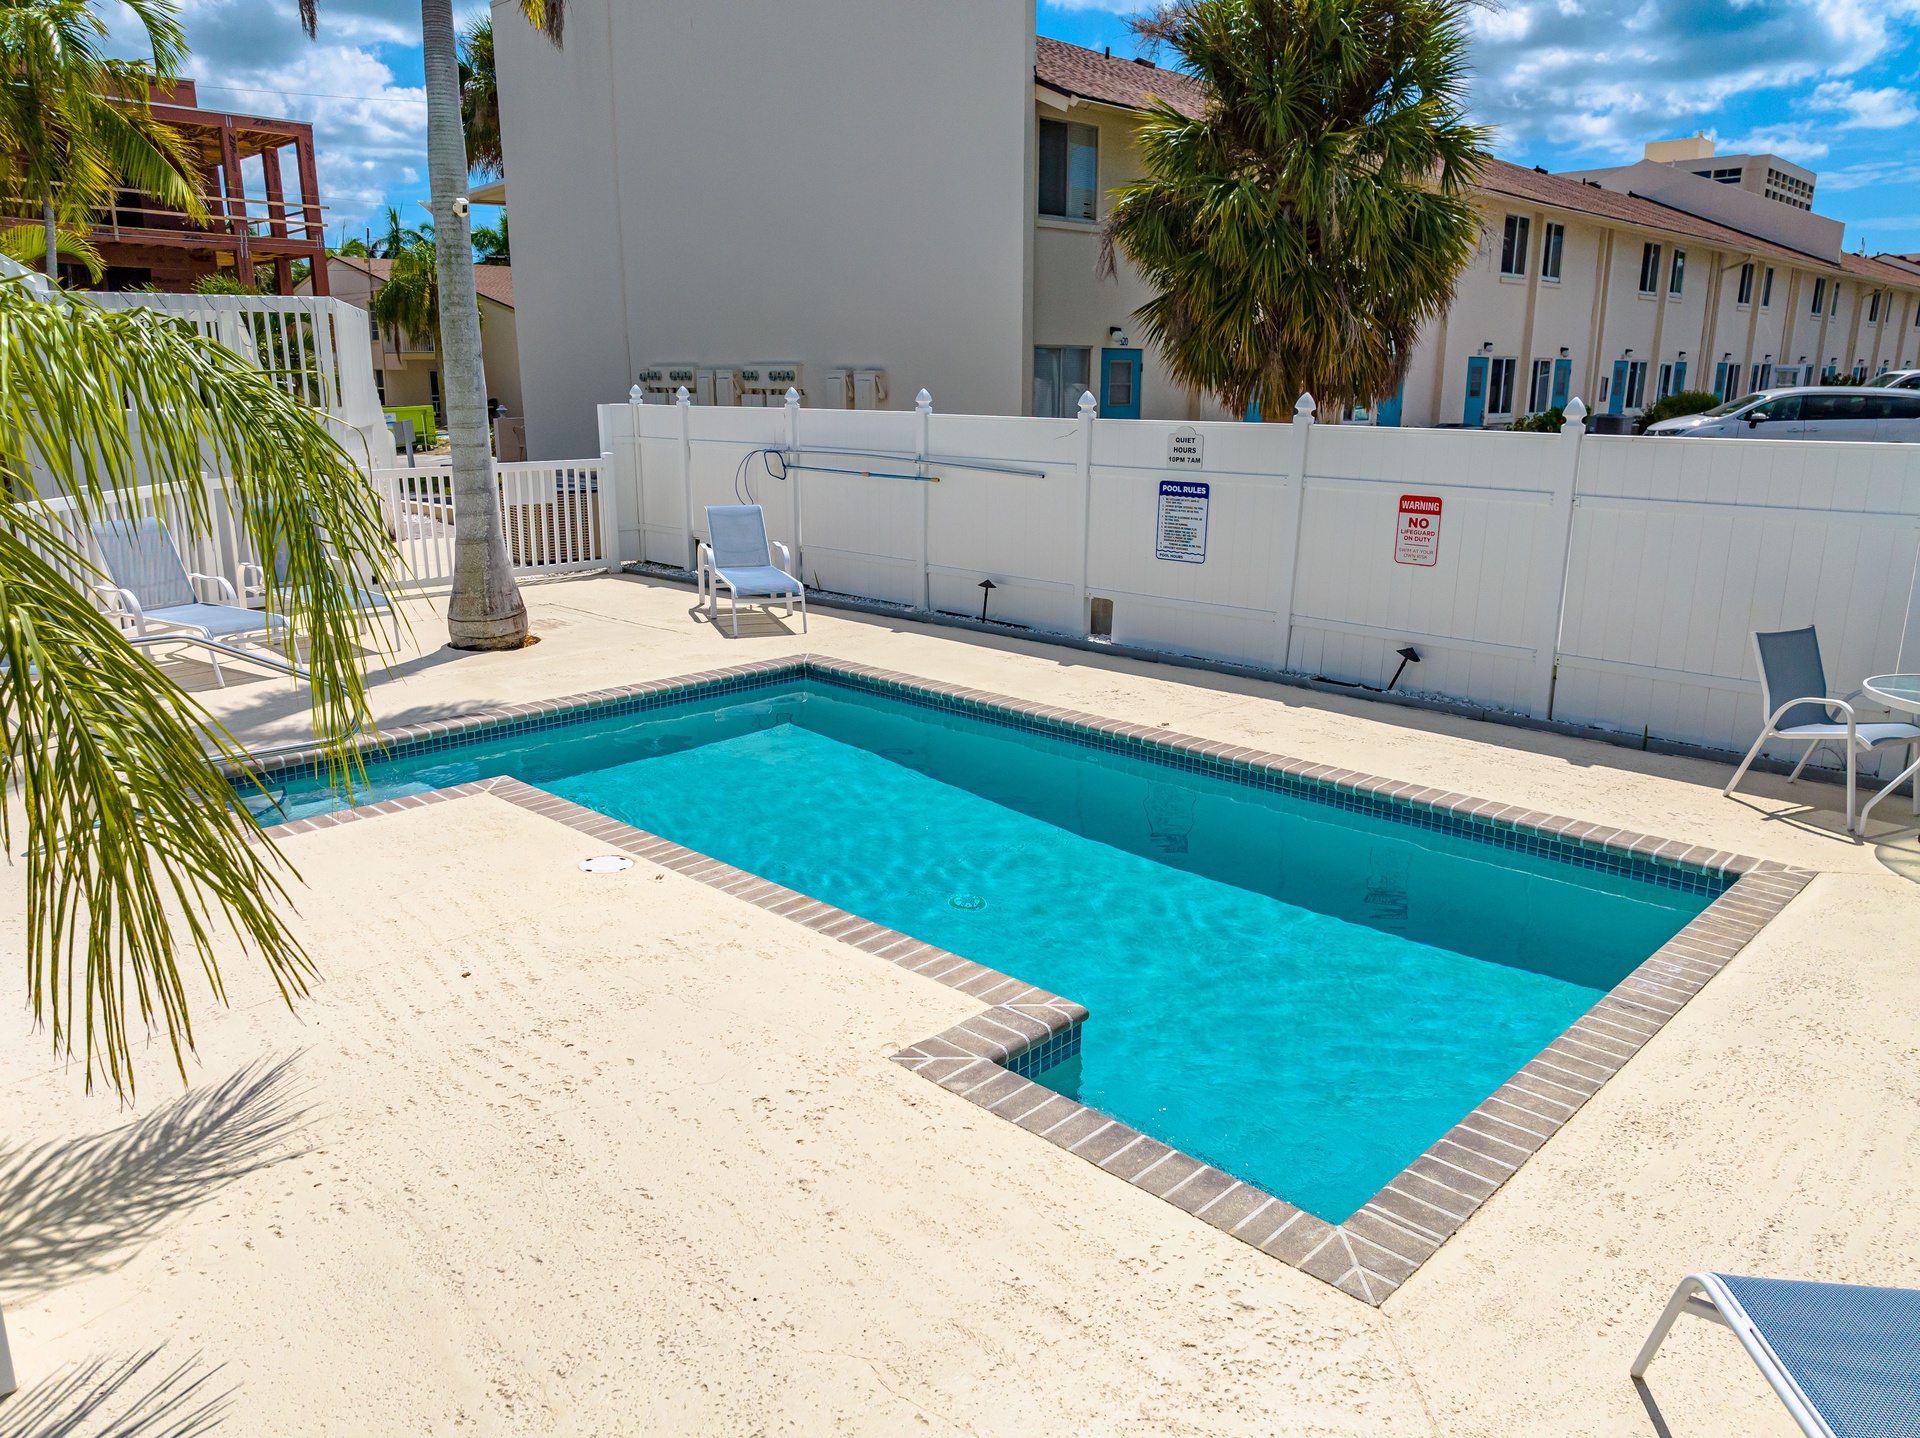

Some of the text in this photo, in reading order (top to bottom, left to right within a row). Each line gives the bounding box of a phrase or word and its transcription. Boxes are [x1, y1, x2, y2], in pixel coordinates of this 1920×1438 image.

[1173, 446, 1197, 454] HOURS
[1162, 484, 1207, 495] POOL RULES
[1402, 500, 1440, 511] WARNING
[1408, 516, 1430, 529] NO
[1401, 529, 1435, 537] LIFEGUARD
